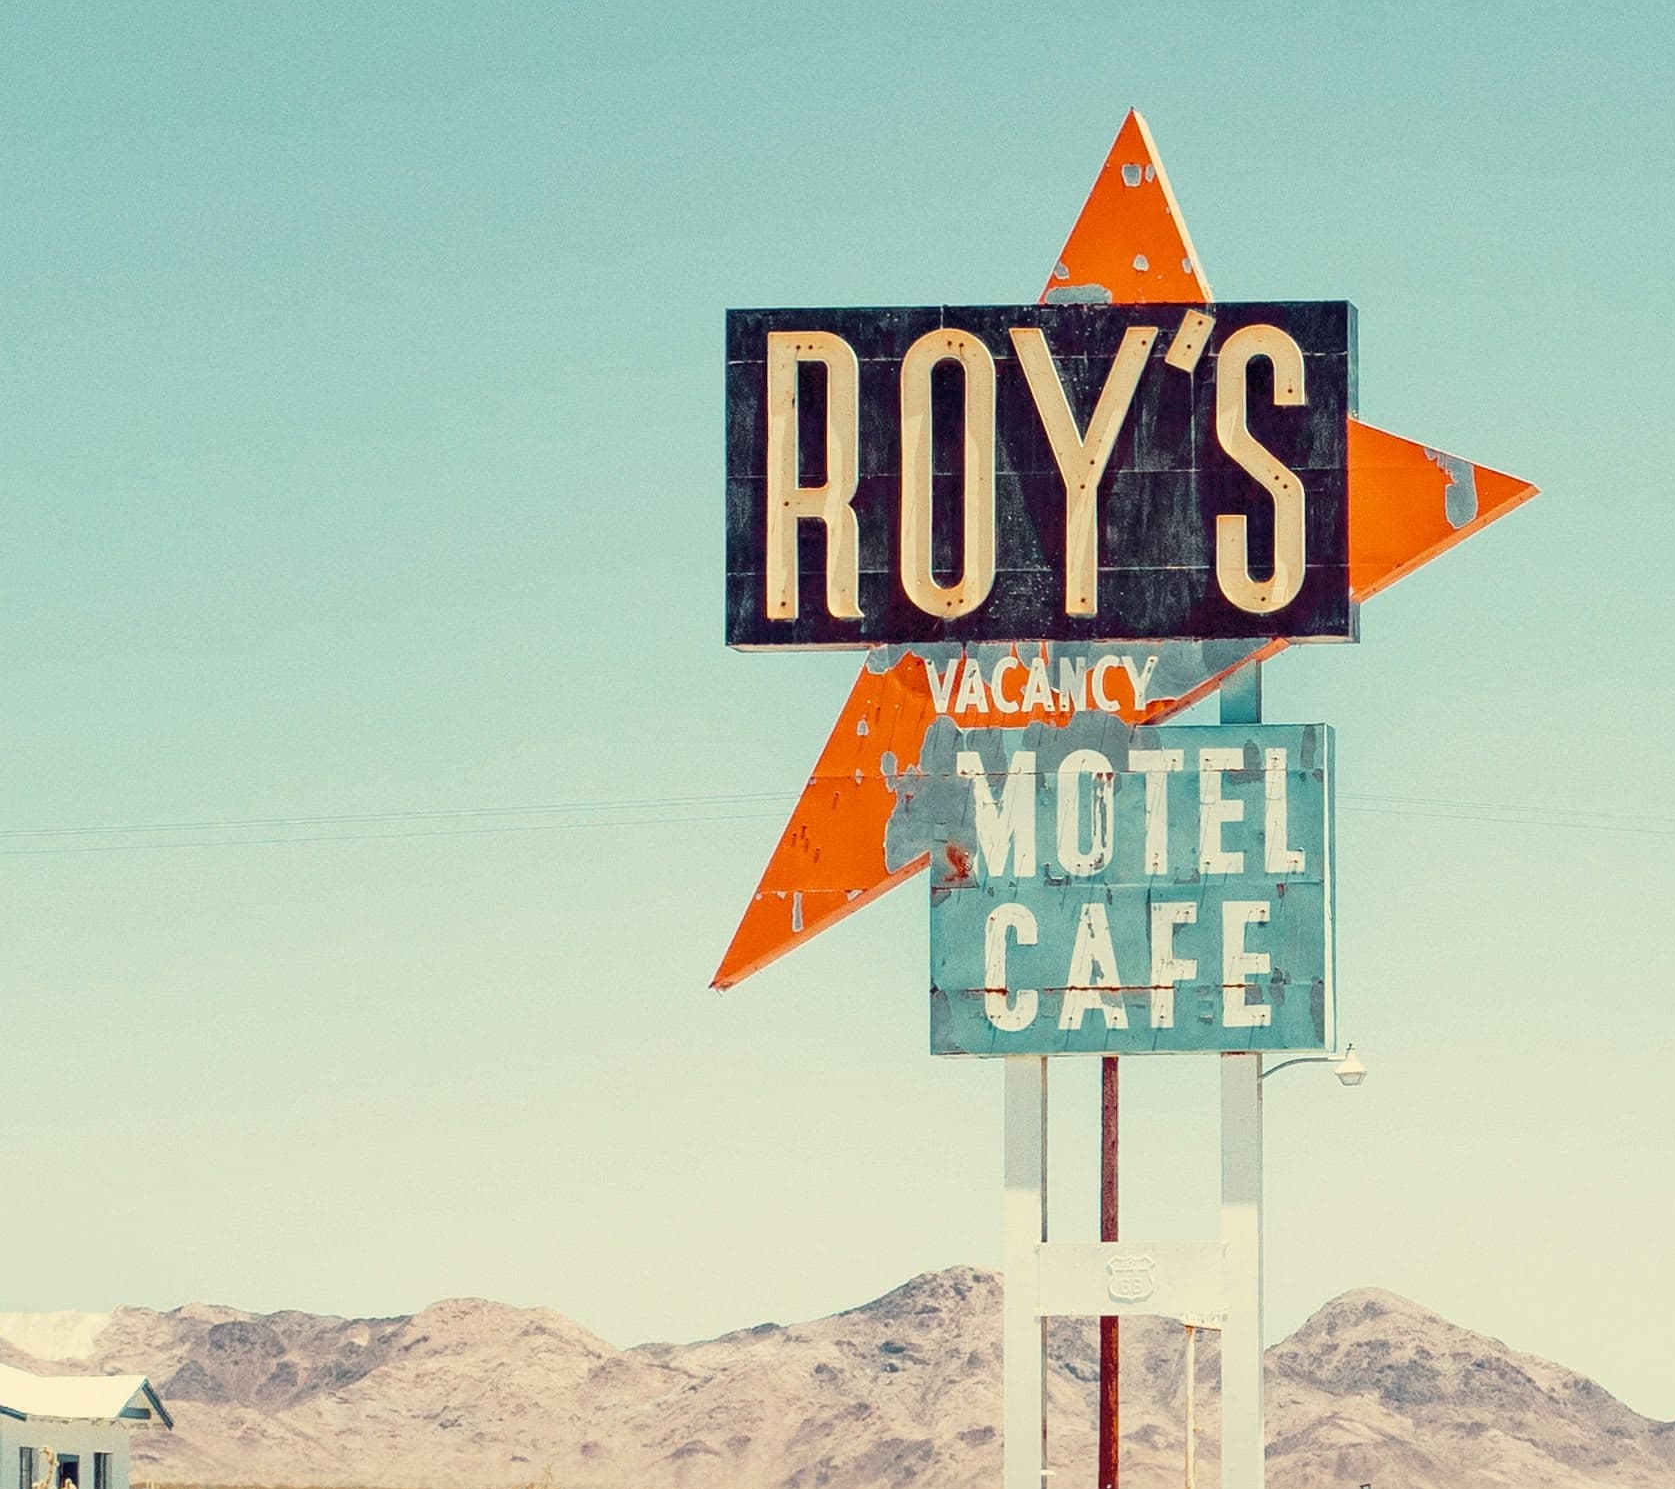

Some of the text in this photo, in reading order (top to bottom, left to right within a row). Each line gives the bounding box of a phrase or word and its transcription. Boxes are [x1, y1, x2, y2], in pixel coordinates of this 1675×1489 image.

[766, 310, 1306, 621] ROY'S
[925, 654, 1159, 714] VACANCY
[956, 748, 1306, 878] MOTEL
[984, 901, 1272, 1032] CAFE
